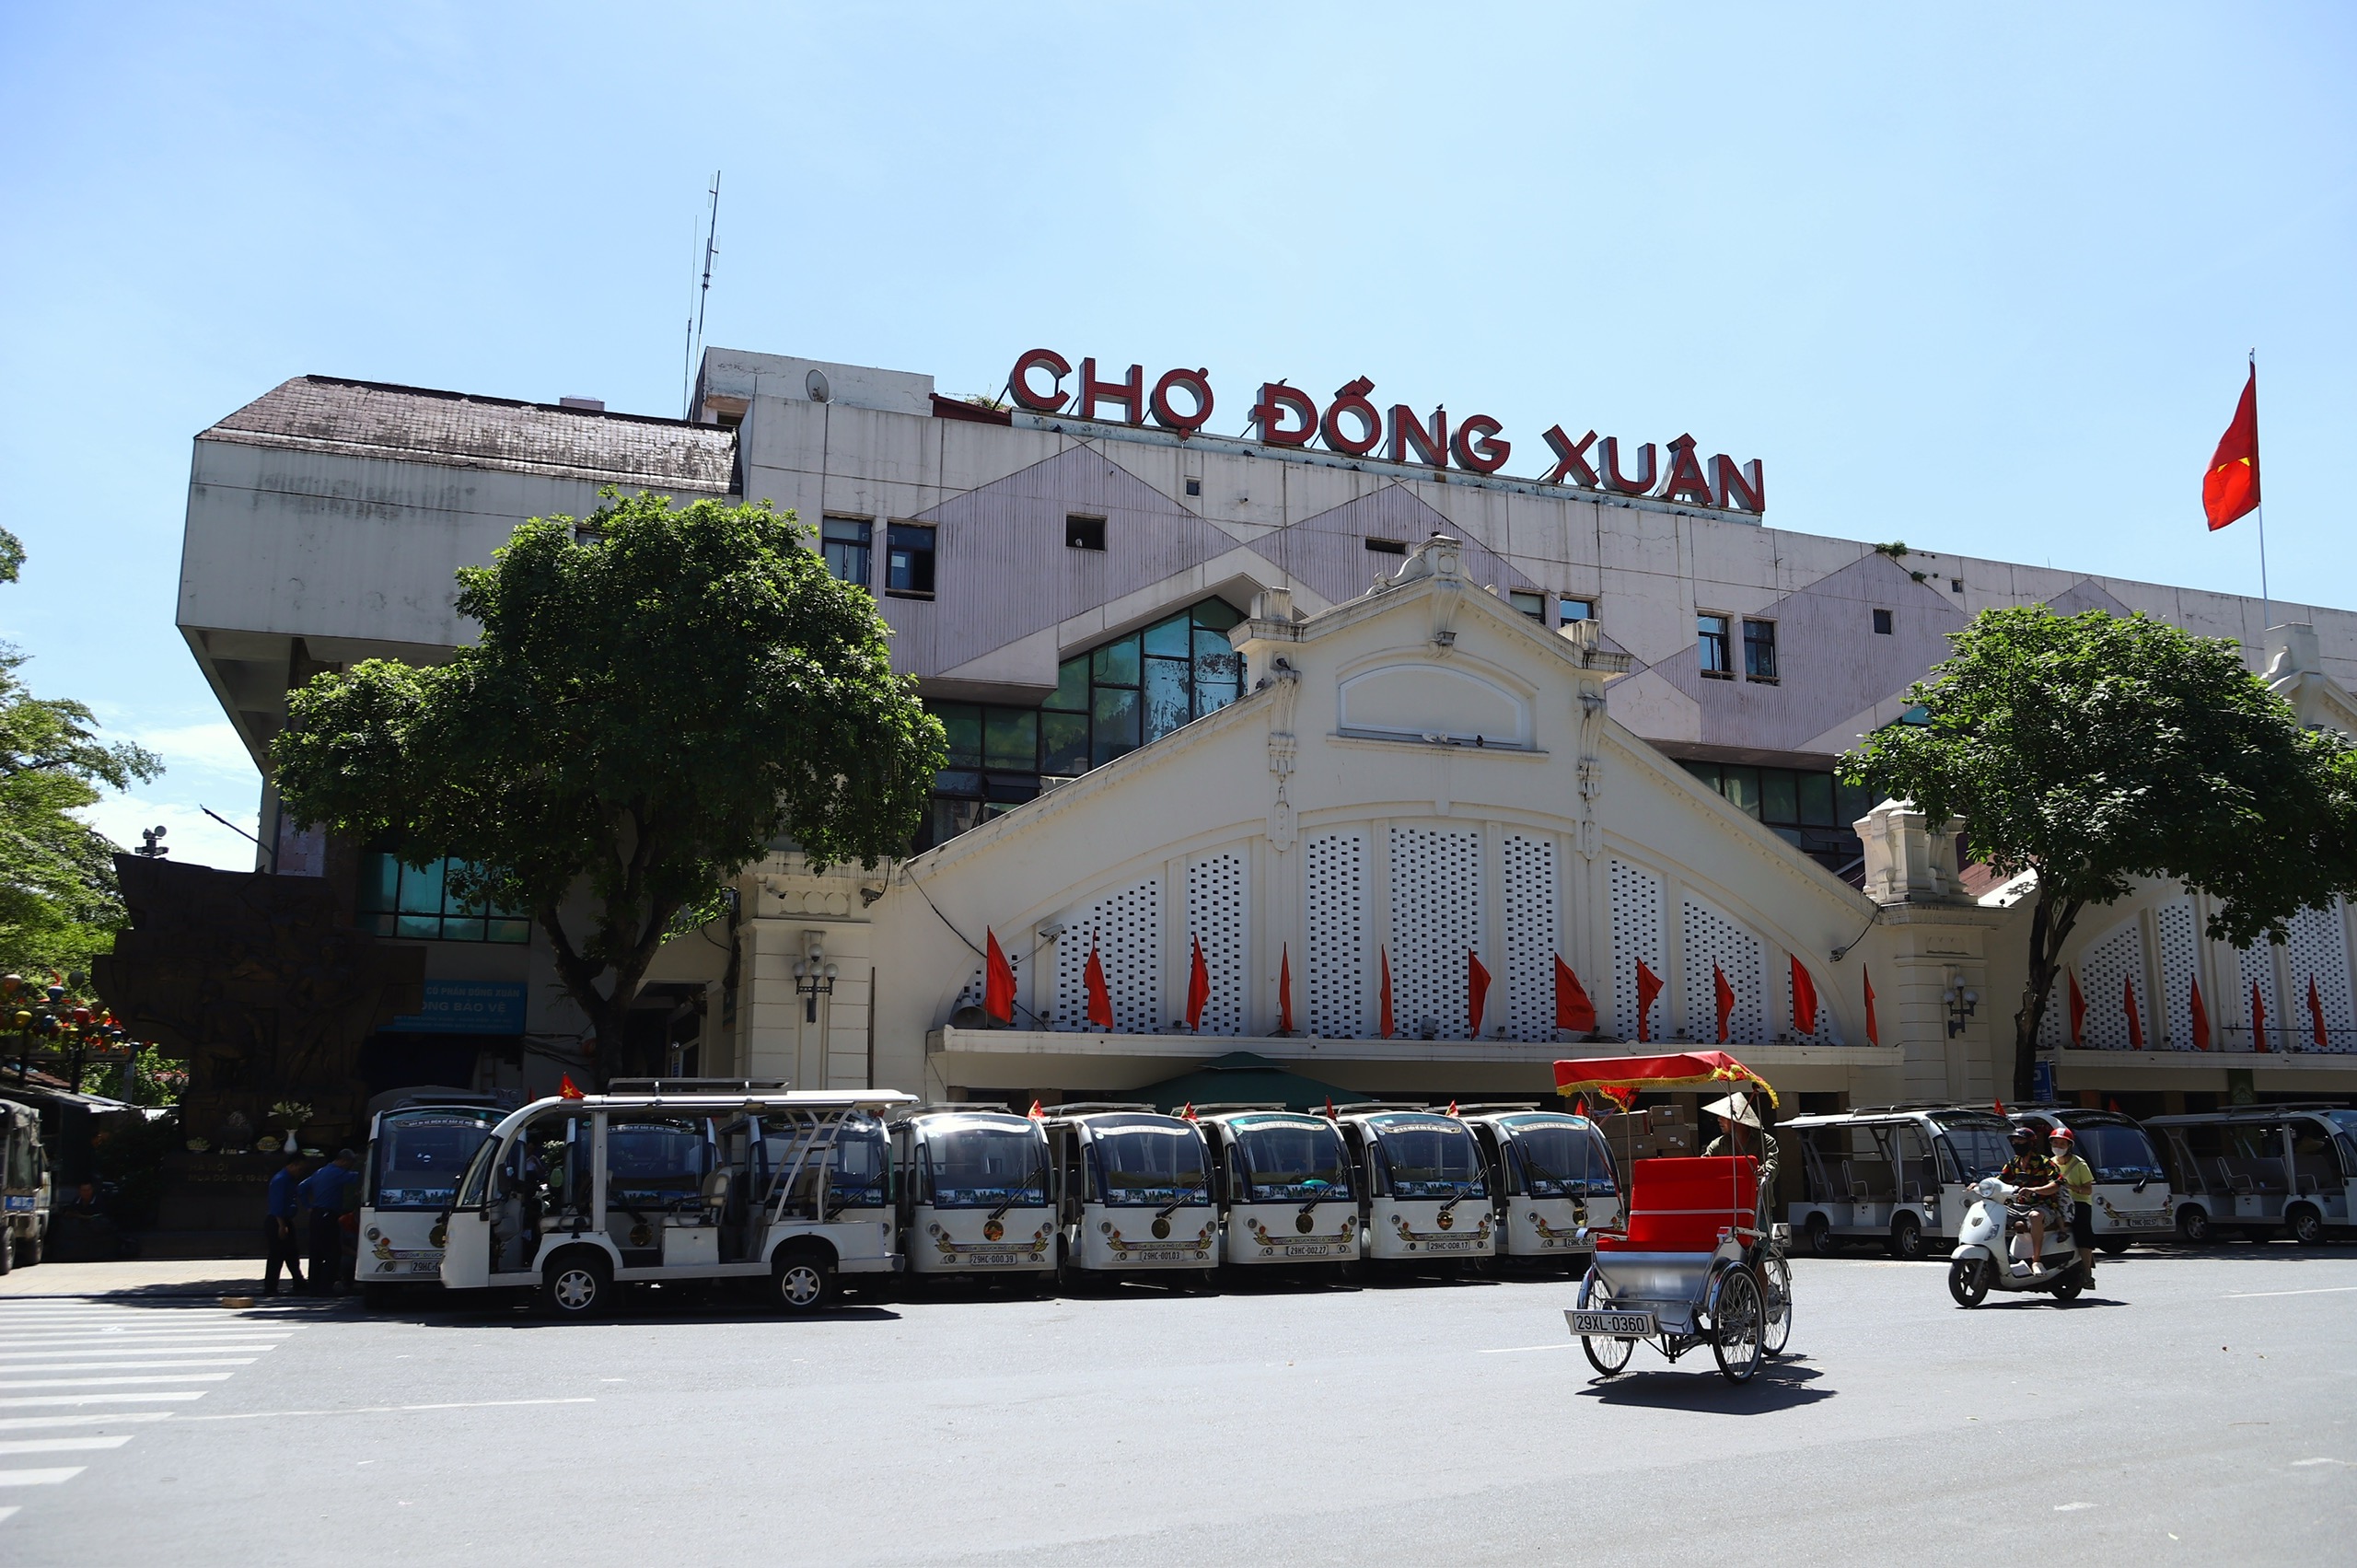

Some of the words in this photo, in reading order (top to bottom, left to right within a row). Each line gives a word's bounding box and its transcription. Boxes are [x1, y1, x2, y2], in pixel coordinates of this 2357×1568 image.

[1009, 348, 1214, 442] CHỢ
[1248, 375, 1511, 473] ĐỒNG
[1541, 424, 1766, 512] XUÂN
[495, 988, 520, 998] XUÂN
[453, 999, 483, 1012] BẢO
[488, 1001, 506, 1015] VỆ
[1144, 1251, 1180, 1260] 29HC-001.03
[1291, 1246, 1327, 1255] 29HC-002.27
[973, 1255, 1014, 1264] 29HC-000.39
[1576, 1315, 1645, 1332] 29XL-0360
